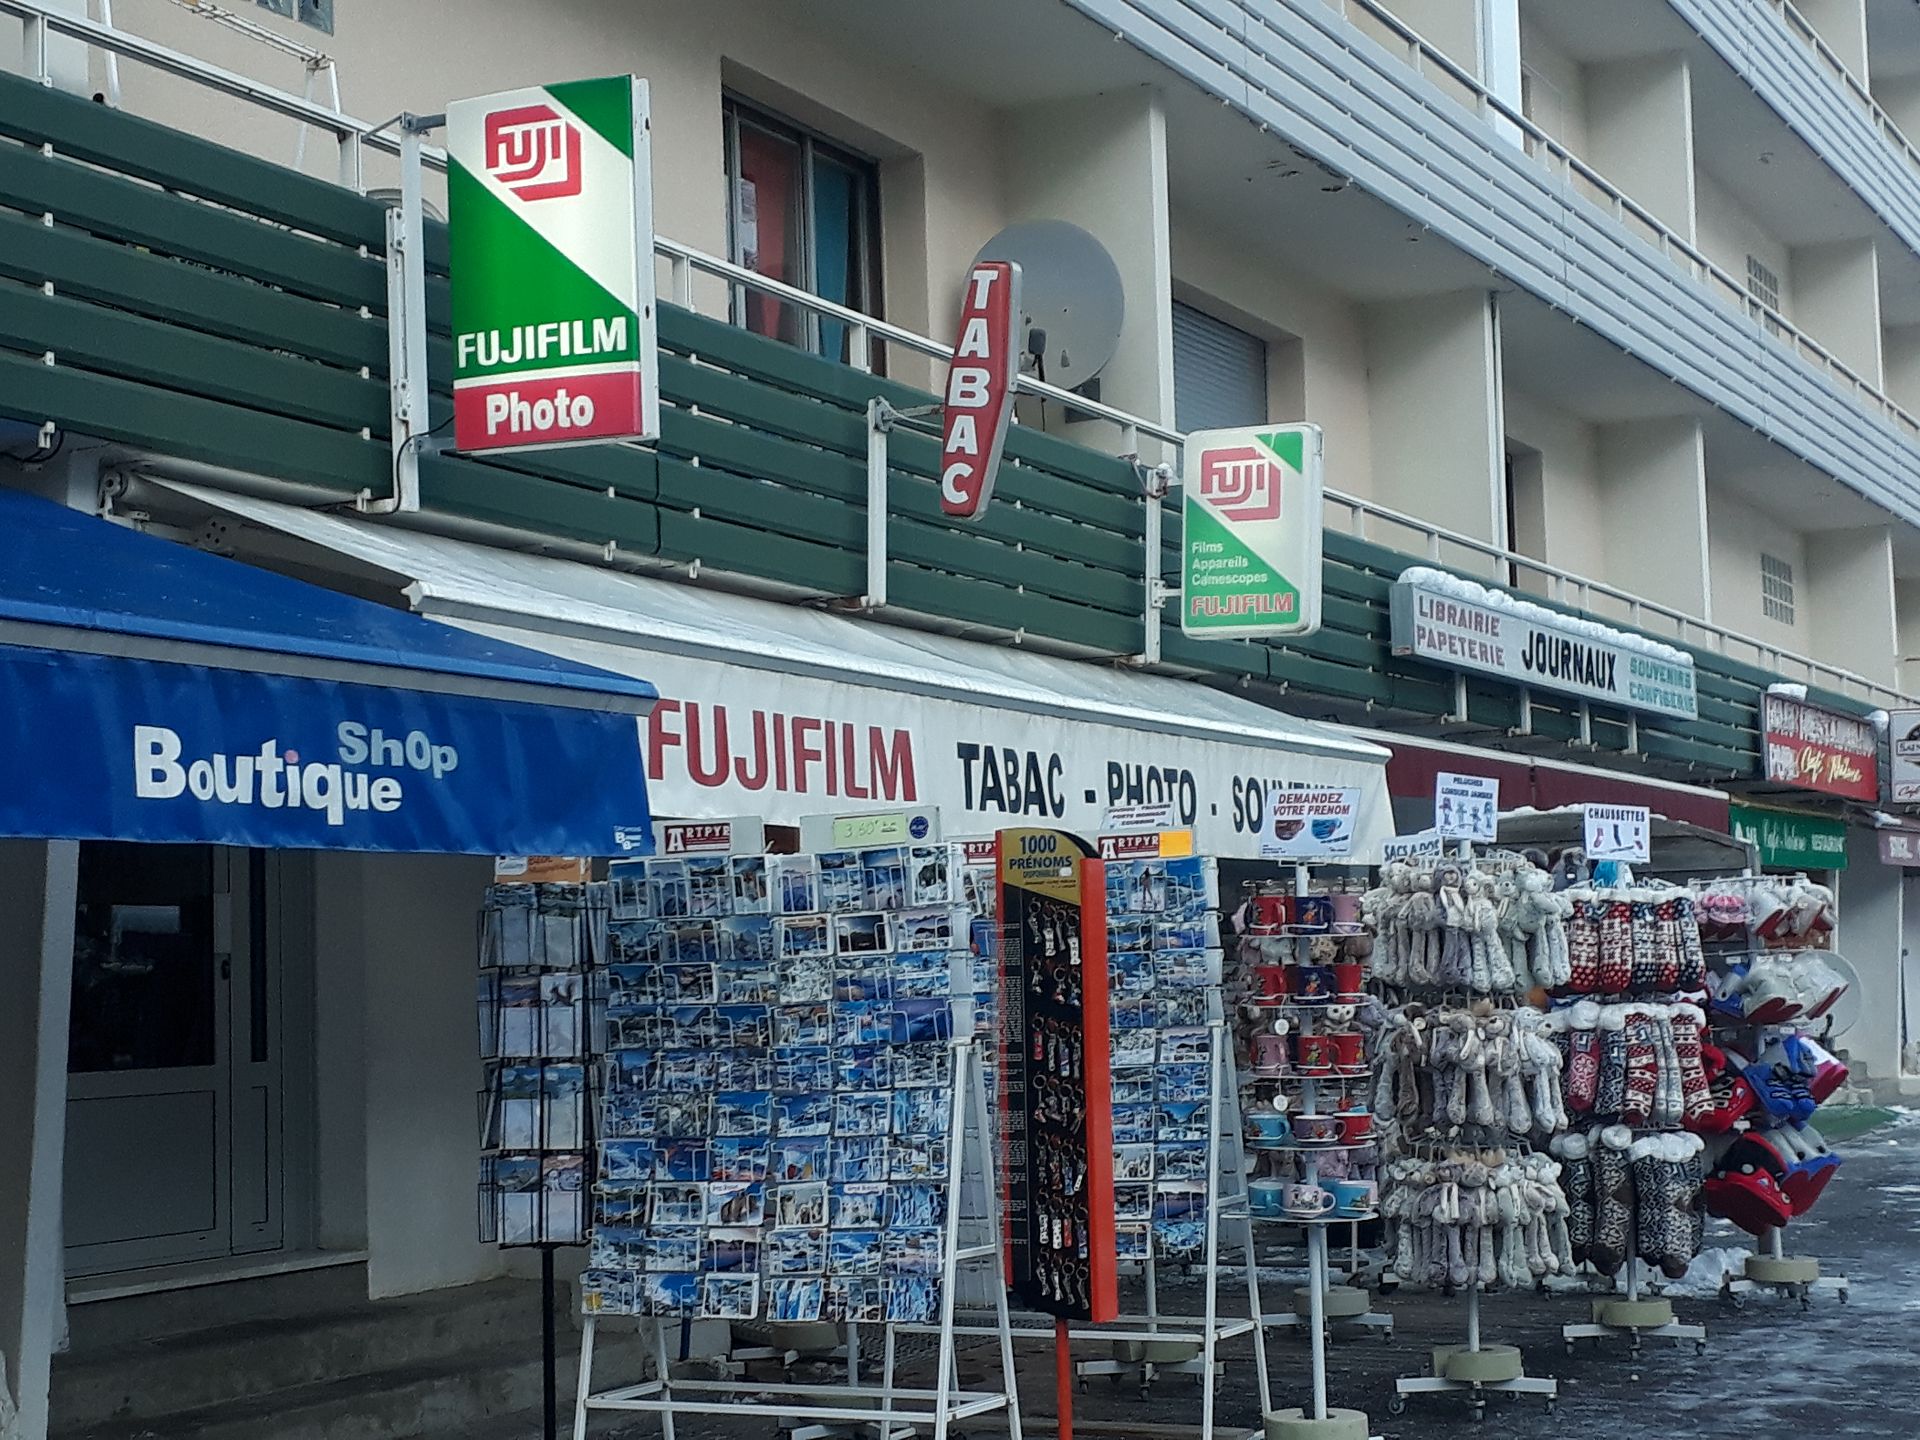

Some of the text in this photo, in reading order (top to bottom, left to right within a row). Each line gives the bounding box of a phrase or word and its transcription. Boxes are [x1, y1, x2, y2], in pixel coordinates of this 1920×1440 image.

[485, 105, 581, 201] FUJI
[458, 316, 627, 368] FUJIFILM
[941, 270, 999, 504] TABAC
[486, 389, 594, 435] Photo
[1201, 447, 1280, 521] FUJI
[1192, 542, 1223, 554] Films
[1192, 557, 1249, 571] Appareils
[1191, 593, 1293, 616] FUJIFILM
[1418, 595, 1500, 637] LIBRAIRIE
[1416, 624, 1505, 667] PAPETERIE
[1521, 630, 1617, 692] JOURNAUX
[648, 699, 917, 801] FUJIFILM
[134, 725, 402, 825] Boutique
[957, 742, 1065, 818] TABAC
[1107, 761, 1196, 825] PHOTO
[1273, 805, 1305, 816] VOTRE
[1278, 793, 1343, 804] DEMANDEZ
[1588, 808, 1645, 822] CHAUSSETTES
[1009, 855, 1073, 869] PRÉNOMS
[1020, 835, 1056, 855] 1000
